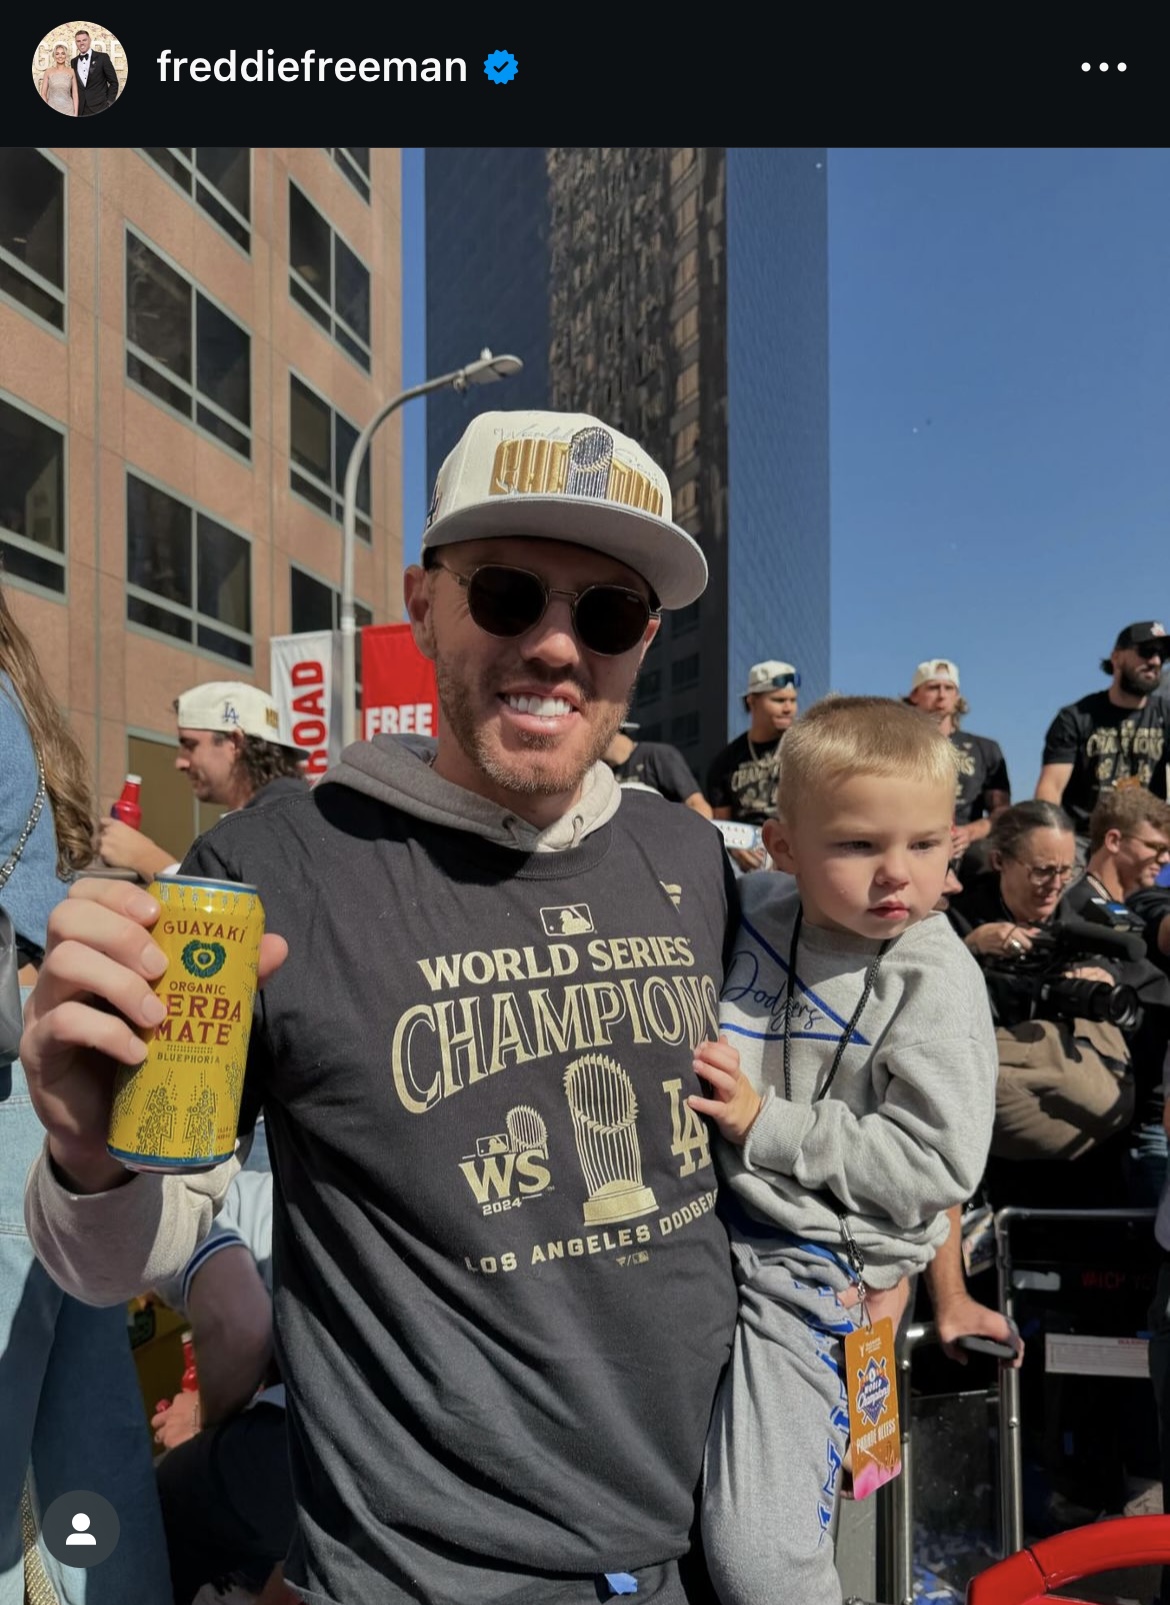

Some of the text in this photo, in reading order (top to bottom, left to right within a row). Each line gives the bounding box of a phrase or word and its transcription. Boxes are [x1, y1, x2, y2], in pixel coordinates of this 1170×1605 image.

[222, 701, 239, 724] LA
[365, 702, 433, 742] FREE
[417, 936, 695, 992] WORLD SERIES
[169, 981, 226, 996] ORGANIC
[719, 951, 823, 1032] Dodgers
[156, 993, 243, 1024] ERBA
[154, 1019, 233, 1046] MATE
[157, 1052, 221, 1064] BLUEPHORIA
[662, 1078, 712, 1178] LA
[458, 1149, 551, 1204] WS
[482, 1197, 522, 1216] 2024
[464, 1252, 517, 1274] LOS
[531, 1224, 651, 1265] ANGELES
